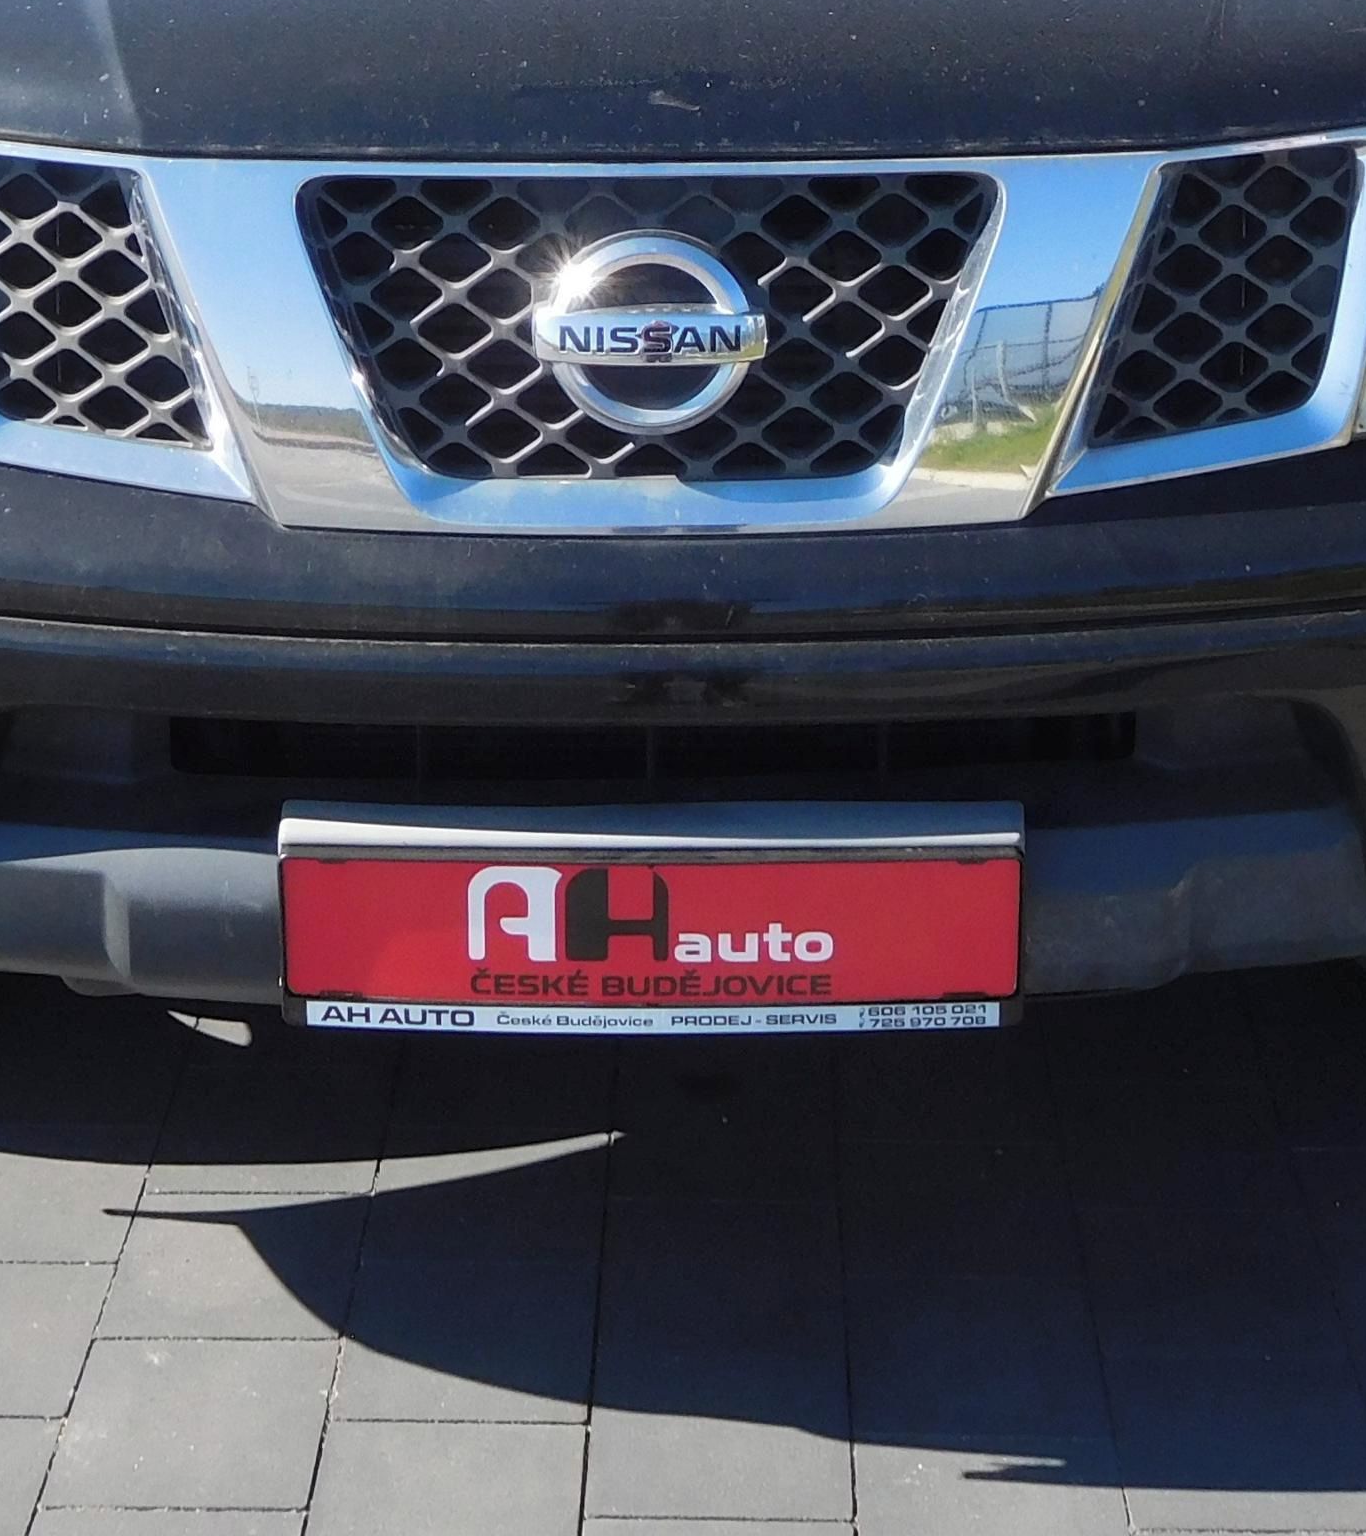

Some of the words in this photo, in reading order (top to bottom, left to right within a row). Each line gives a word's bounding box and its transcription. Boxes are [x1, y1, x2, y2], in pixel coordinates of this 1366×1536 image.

[559, 324, 742, 354] NISSAN
[470, 967, 589, 996] ČESKÉ
[601, 968, 832, 997] BUDĚJOVICE
[321, 1005, 371, 1023] AH
[378, 1007, 475, 1027] AUTO
[496, 1009, 552, 1026] České
[556, 1014, 654, 1029] Budějovice
[911, 1005, 947, 1015] 105
[951, 1004, 987, 1014] 021
[671, 1014, 752, 1027] PRODEJ
[766, 1013, 837, 1026] SERVIS
[910, 1016, 946, 1026] 970
